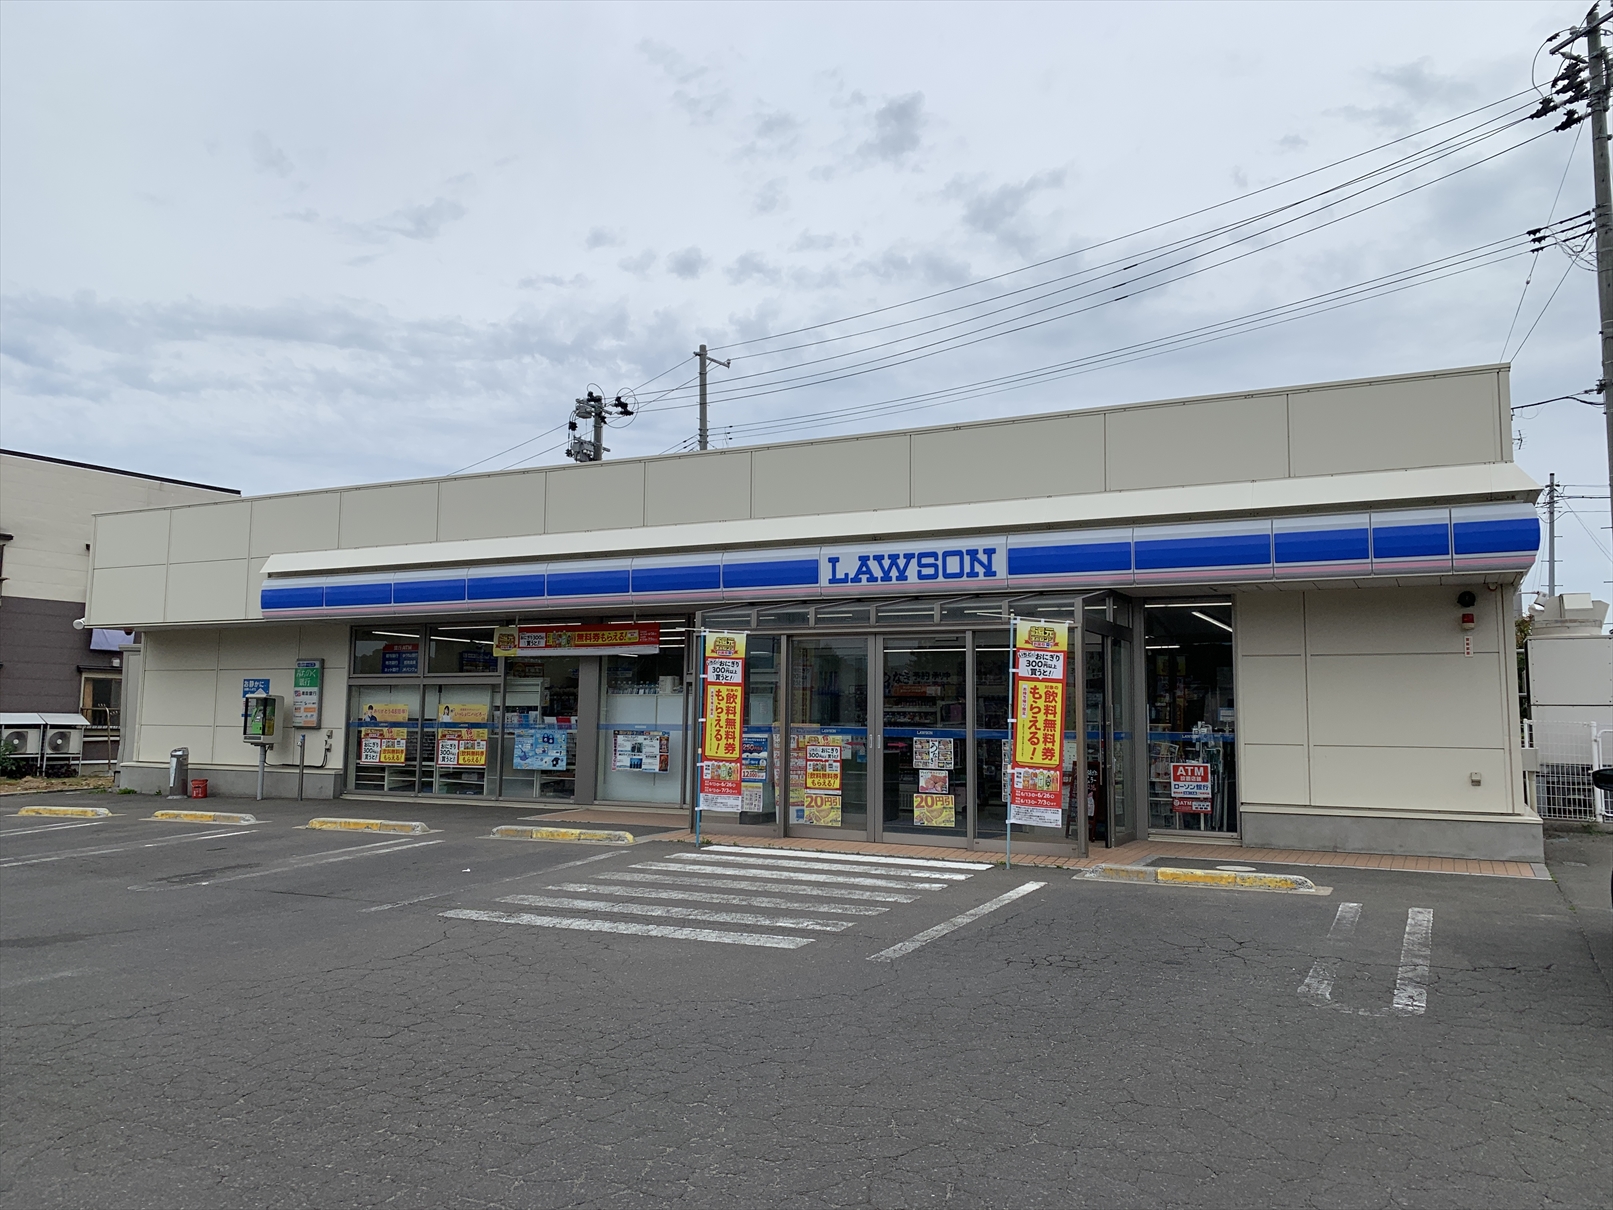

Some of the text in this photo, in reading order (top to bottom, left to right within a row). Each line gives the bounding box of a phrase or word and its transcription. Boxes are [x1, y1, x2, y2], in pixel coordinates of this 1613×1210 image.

[828, 548, 996, 584] LAWSON
[1035, 653, 1060, 662] おにぎり
[714, 689, 725, 755] もらえる!
[724, 692, 738, 755] 飲料無料券
[1028, 685, 1043, 760] もらえる!
[1041, 690, 1058, 761] 飲料無料券
[1177, 767, 1204, 776] ATM
[806, 795, 841, 809] 20円引
[915, 795, 954, 809] 20円引
